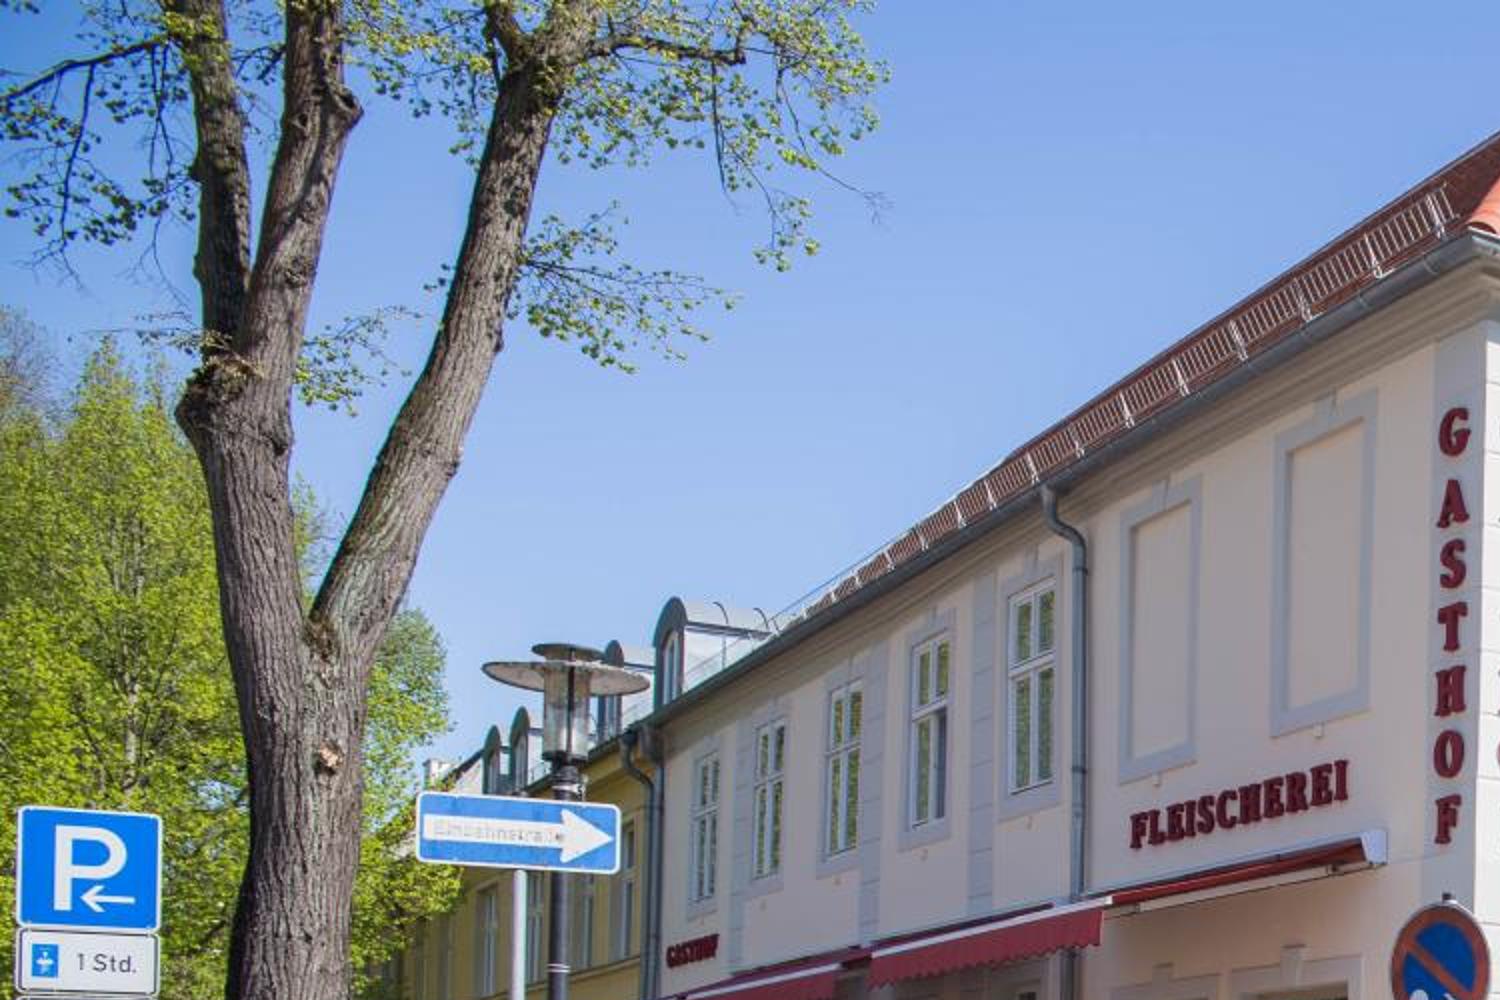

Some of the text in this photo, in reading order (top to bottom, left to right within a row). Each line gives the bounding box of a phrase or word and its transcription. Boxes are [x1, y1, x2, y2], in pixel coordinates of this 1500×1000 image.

[1433, 406, 1471, 845] GASTHOF
[1130, 759, 1349, 850] FLEISCHEREI
[54, 824, 127, 911] P
[78, 953, 136, 973] 1 Std.
